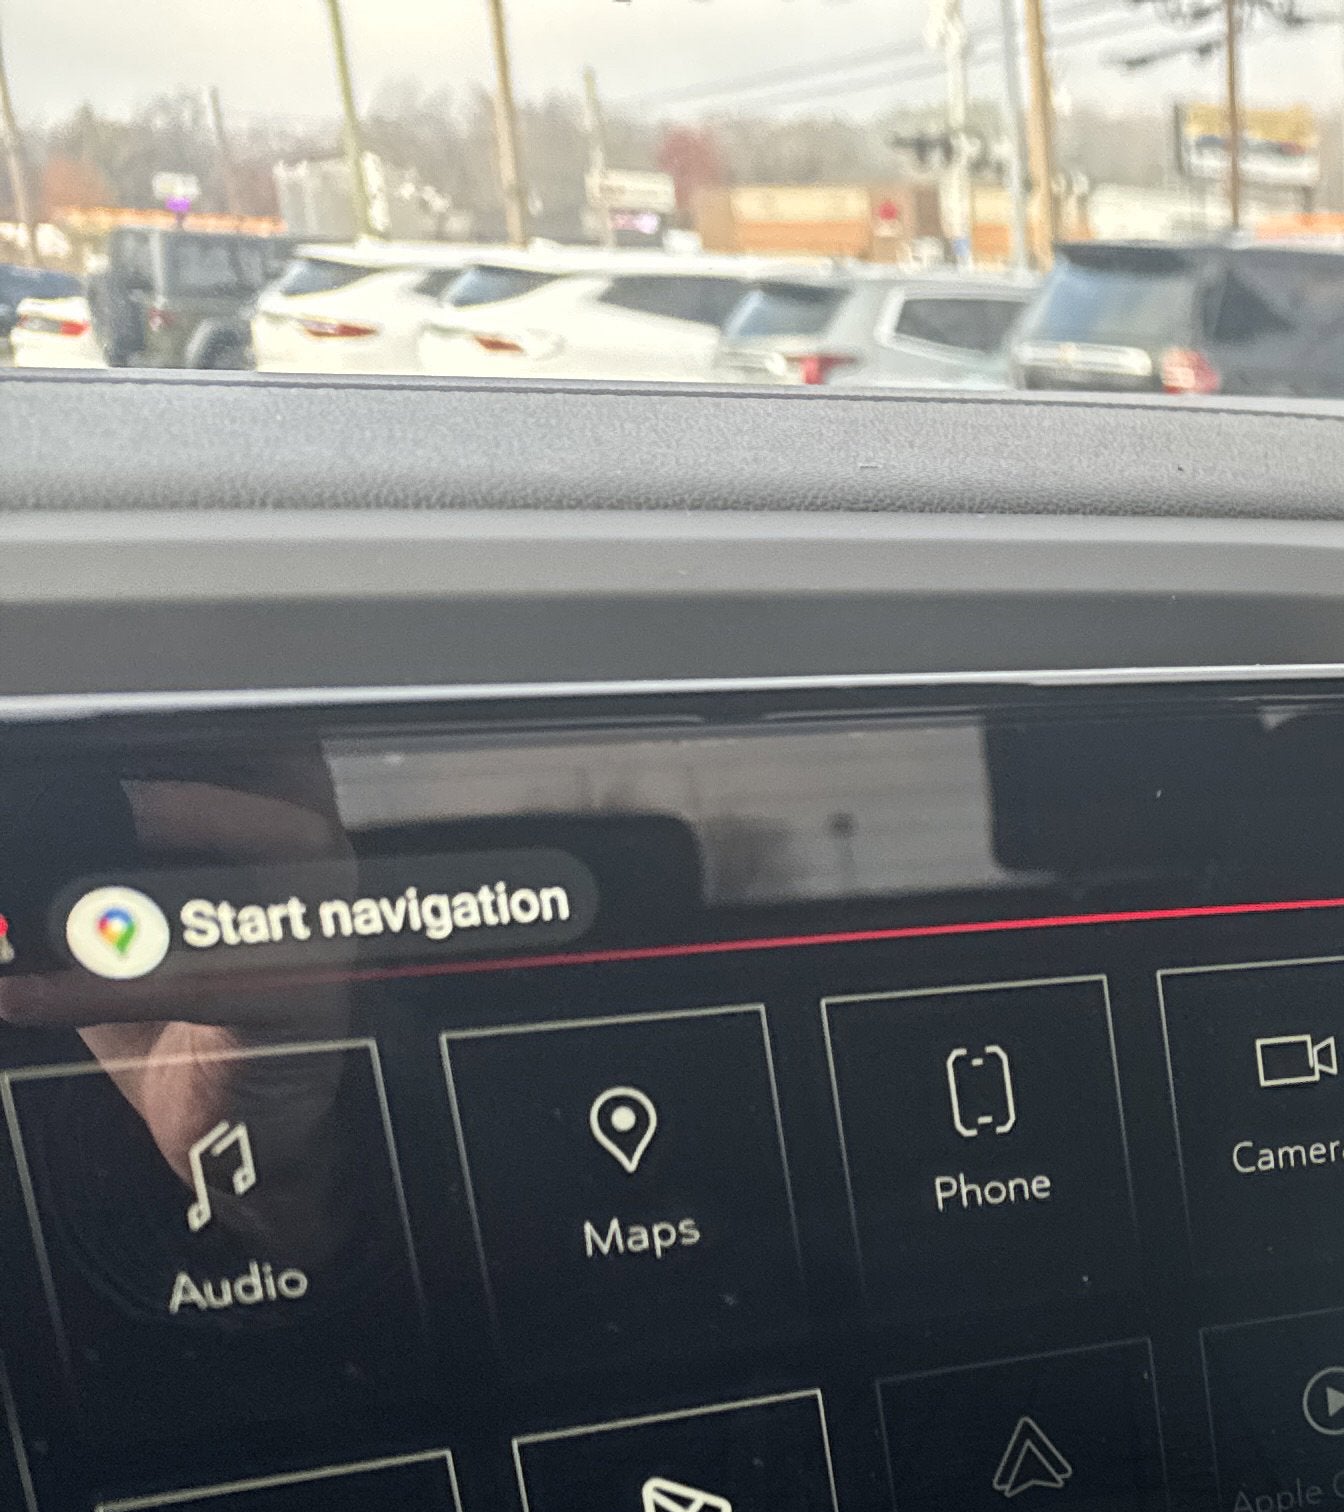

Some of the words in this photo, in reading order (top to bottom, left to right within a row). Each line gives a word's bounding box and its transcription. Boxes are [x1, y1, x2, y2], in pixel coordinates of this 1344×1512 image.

[180, 896, 310, 947] Start
[319, 881, 570, 940] navigation
[934, 1172, 1051, 1211] Phone
[583, 1216, 701, 1258] Maps
[169, 1261, 308, 1313] Audio
